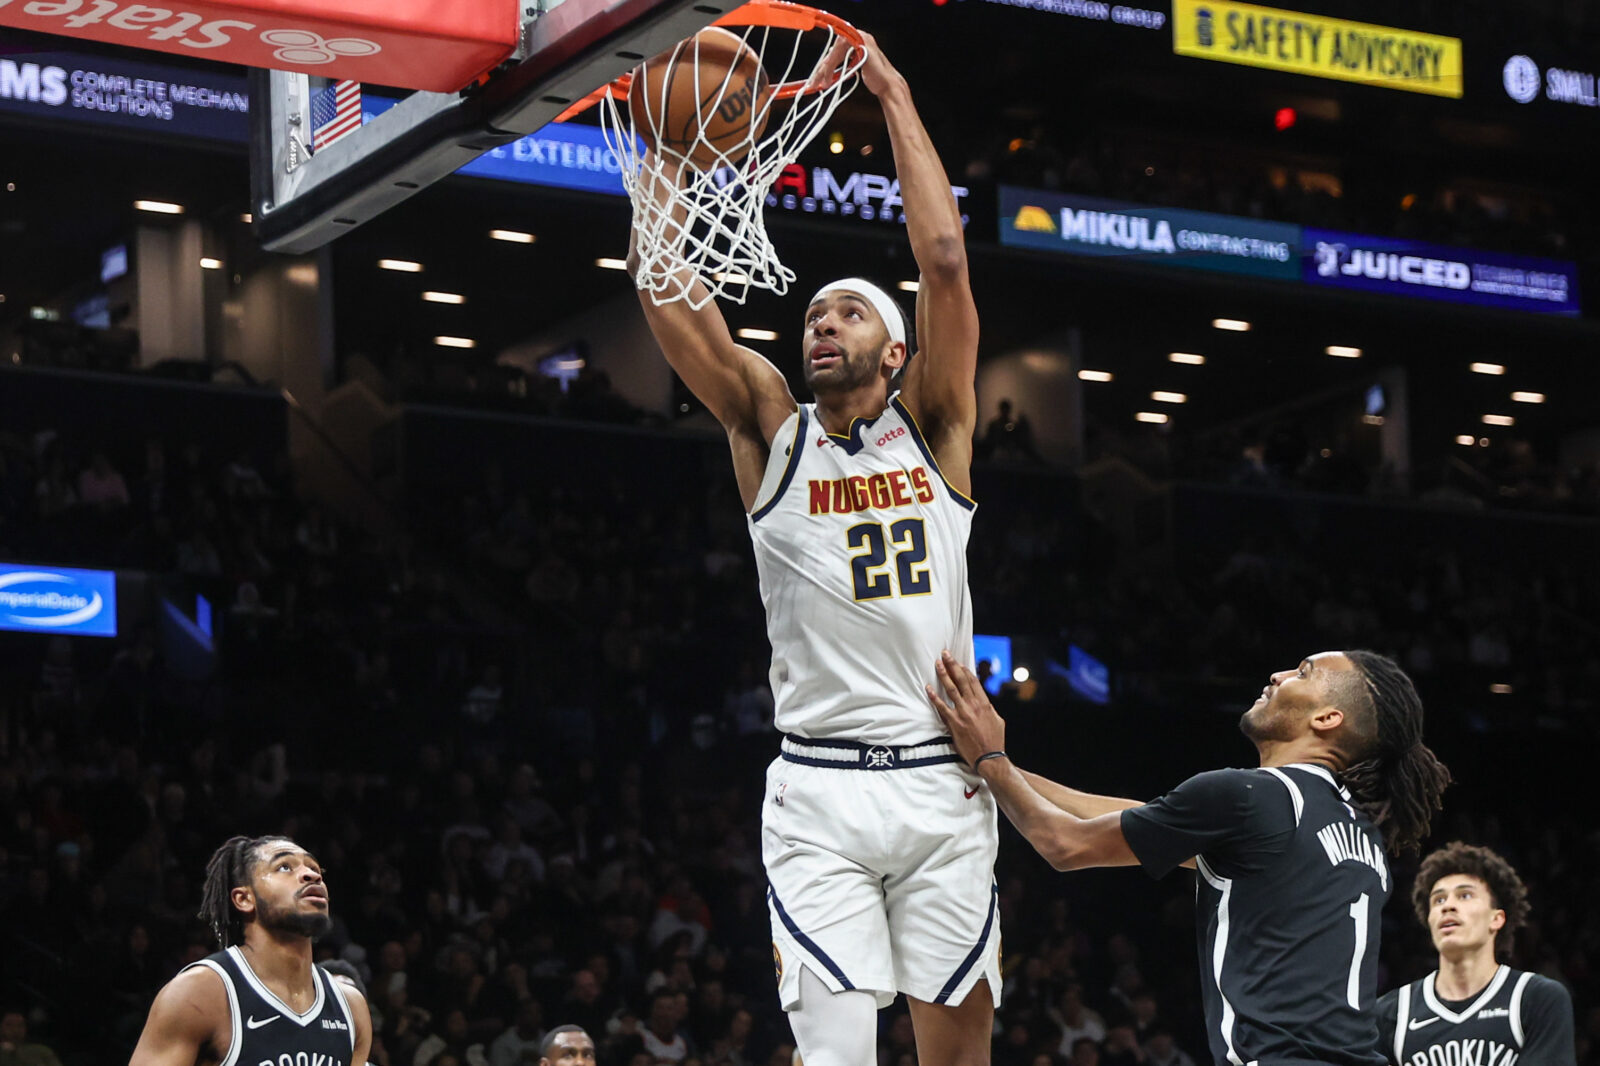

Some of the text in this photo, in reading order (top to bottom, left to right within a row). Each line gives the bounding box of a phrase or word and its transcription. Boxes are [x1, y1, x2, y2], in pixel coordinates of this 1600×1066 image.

[1226, 11, 1443, 82] SAFETY ADVISORY
[70, 70, 167, 101] COMPLETE
[71, 88, 174, 120] SOLUTIONS
[1060, 206, 1290, 262] MIKULA CONTRACTING
[1341, 249, 1470, 290] JUICED
[875, 427, 905, 447] otta
[808, 466, 935, 515] NUGGES
[846, 517, 932, 602] 22
[1346, 892, 1369, 1011] 1
[1403, 1038, 1519, 1066] ROOKLYN
